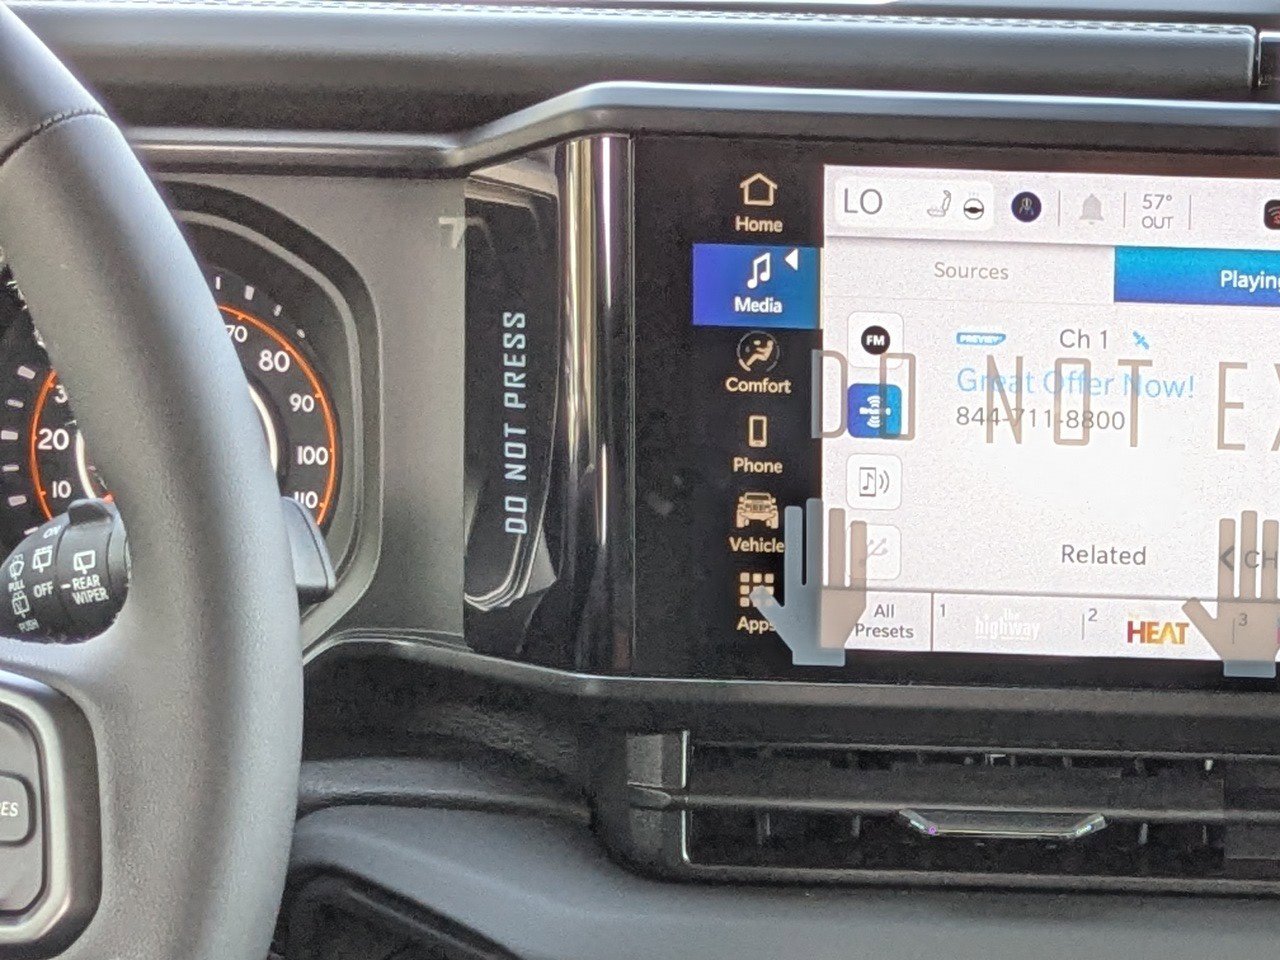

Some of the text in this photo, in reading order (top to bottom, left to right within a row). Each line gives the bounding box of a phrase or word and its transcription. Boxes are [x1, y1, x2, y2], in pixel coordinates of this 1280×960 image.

[842, 187, 884, 216] LO
[1141, 193, 1174, 212] 57°
[735, 215, 784, 234] Home
[1141, 214, 1175, 230] OUT
[933, 260, 1010, 281] Sources
[734, 296, 784, 315] Media
[225, 325, 248, 343] 70
[866, 335, 885, 346] FM
[1058, 327, 1110, 350] Ch 1
[258, 349, 290, 373] 80
[724, 376, 792, 395] Comfort
[957, 367, 1196, 399] Great Offer Now!
[289, 393, 315, 412] 90
[811, 349, 917, 441] DO
[985, 354, 1154, 447] NOT
[503, 311, 528, 535] DO NOT PRESS
[955, 405, 1126, 431] 844-711-8800
[38, 428, 70, 451] 20
[297, 446, 329, 466] 100
[733, 456, 783, 475] Phone
[52, 480, 72, 499] 10
[729, 536, 785, 554] Vehicle
[1061, 543, 1147, 566] Related
[1244, 550, 1278, 570] CH
[33, 581, 54, 598] OFF
[71, 574, 101, 591] REAR
[71, 587, 110, 605] WIPER
[874, 604, 895, 619] All
[940, 604, 947, 617] 1
[1088, 609, 1098, 622] 2
[1238, 613, 1248, 627] 3
[855, 623, 914, 639] Presets
[1127, 621, 1190, 644] HEAT
[0, 801, 19, 817] ES
